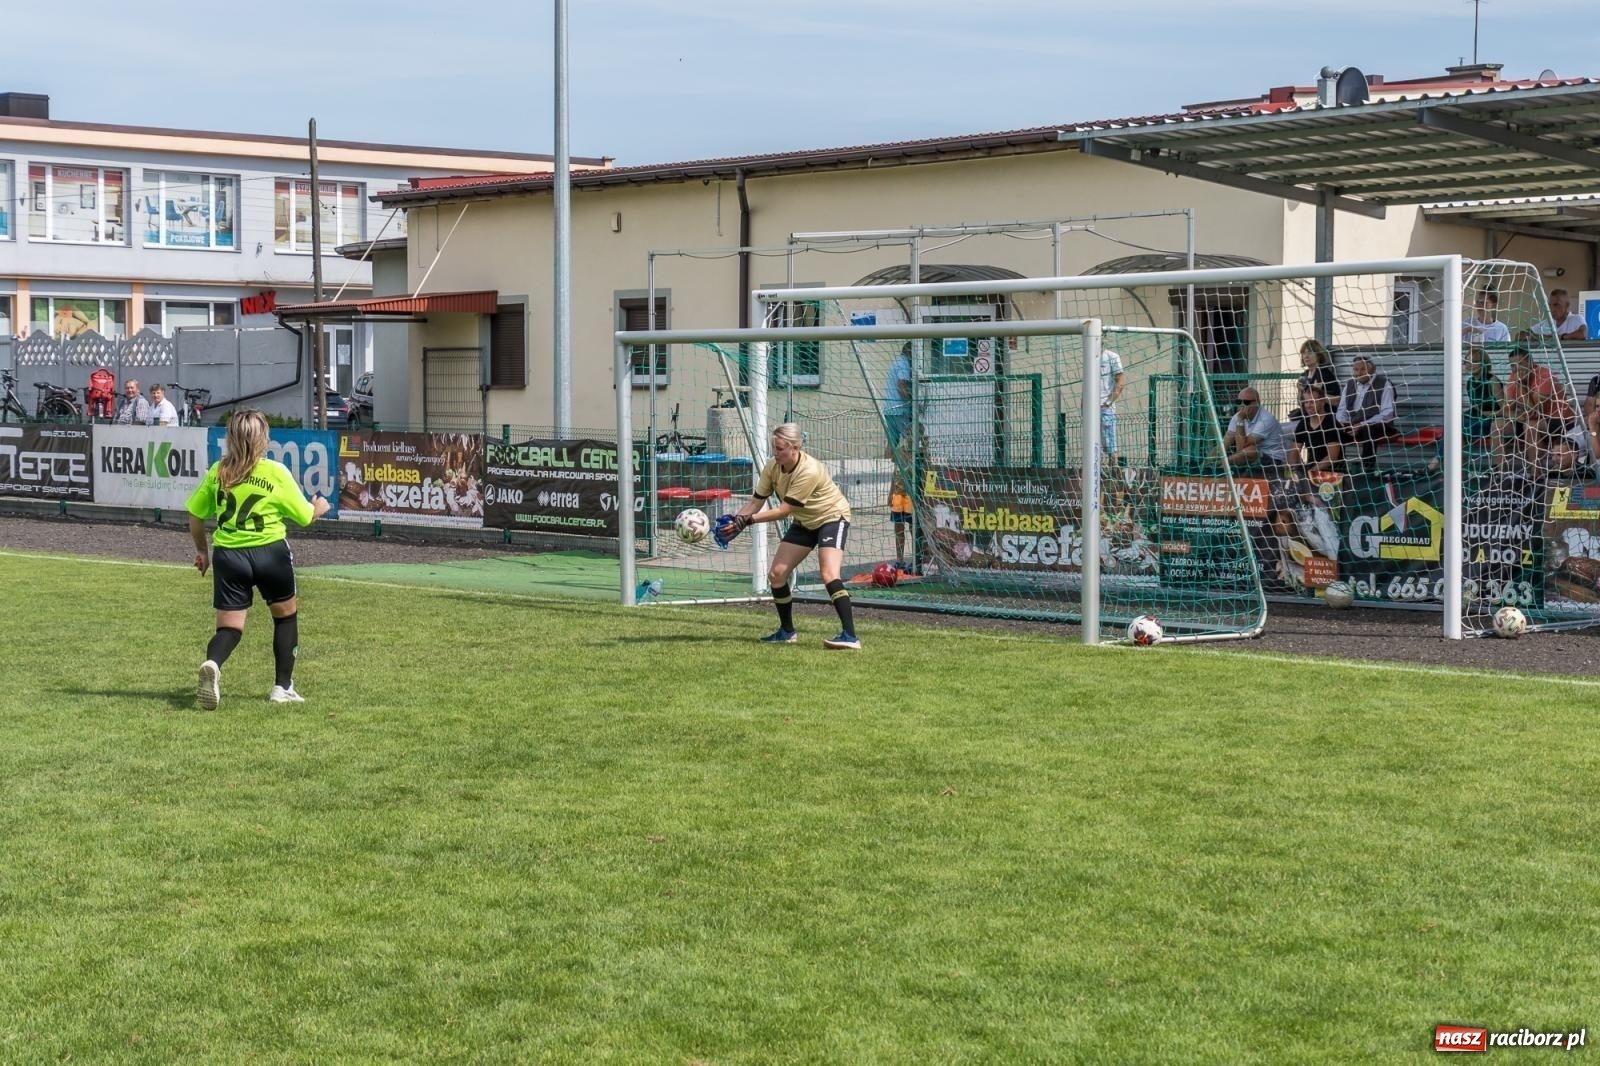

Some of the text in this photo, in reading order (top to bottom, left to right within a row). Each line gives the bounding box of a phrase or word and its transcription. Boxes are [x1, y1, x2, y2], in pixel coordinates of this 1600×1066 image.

[101, 441, 199, 478] KERAKOLL
[581, 447, 640, 470] CENTR
[385, 477, 446, 510] szefa
[497, 488, 524, 504] JAKO
[550, 491, 580, 509] errea
[217, 489, 267, 533] 26
[1461, 523, 1532, 540] UDUJEMY
[1475, 548, 1486, 563] A
[1490, 549, 1516, 563] DO
[1522, 550, 1533, 565] Z
[1387, 576, 1429, 599] 665
